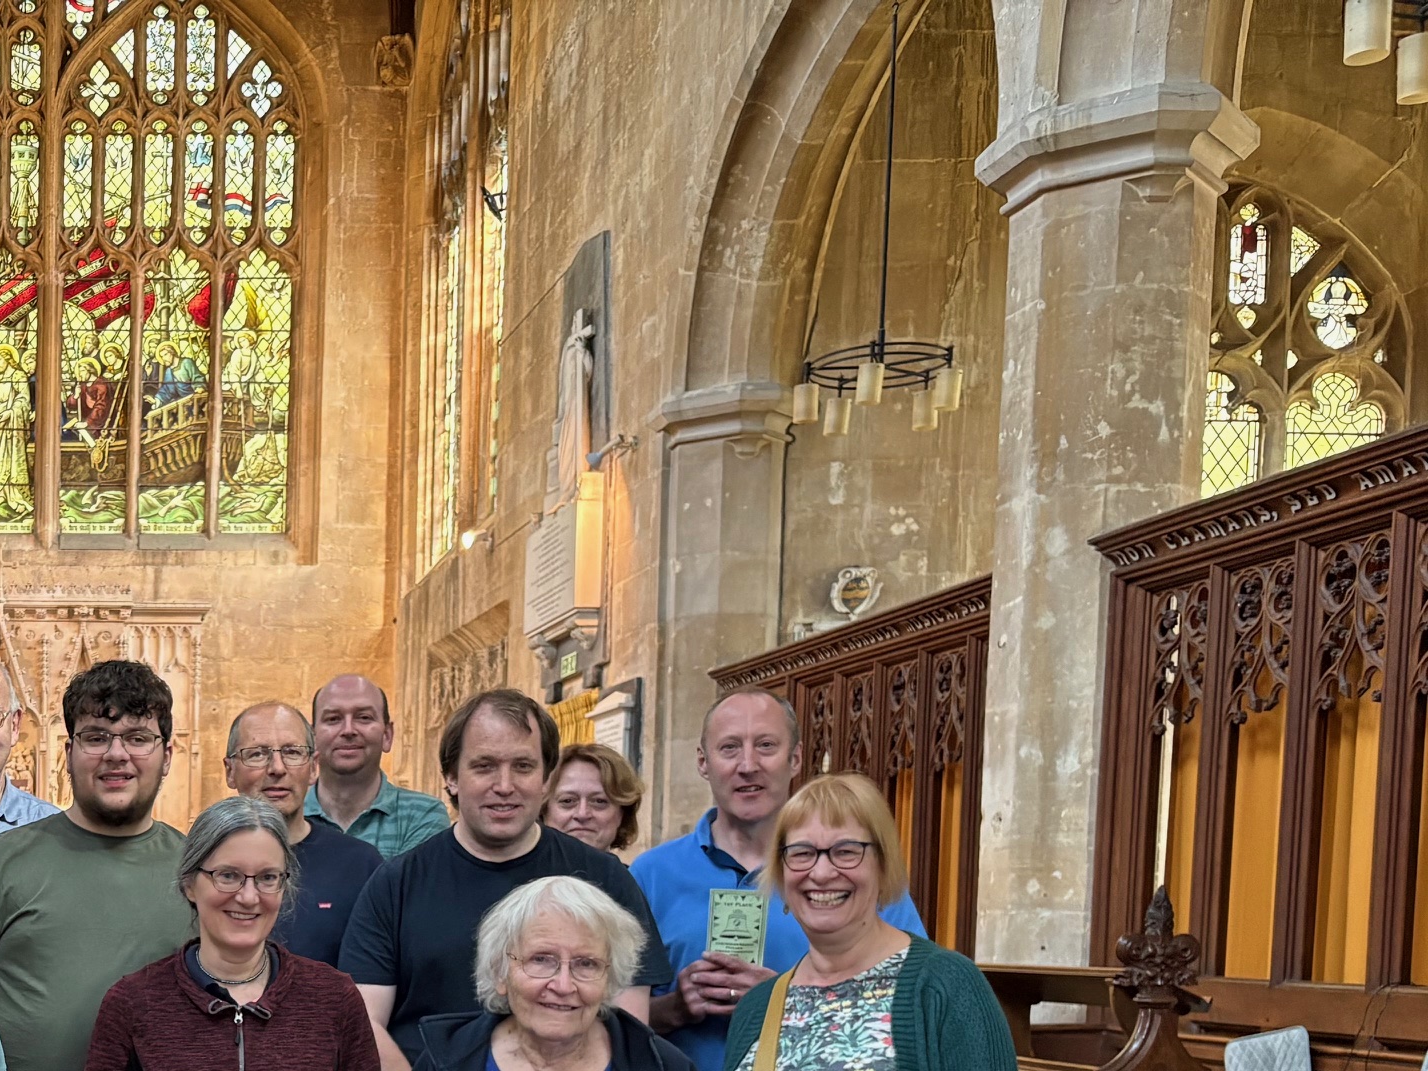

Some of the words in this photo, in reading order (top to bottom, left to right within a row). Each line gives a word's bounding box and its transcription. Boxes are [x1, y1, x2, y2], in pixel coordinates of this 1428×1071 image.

[1112, 542, 1156, 566] NON
[1283, 484, 1336, 514] SED
[956, 597, 986, 616] SED
